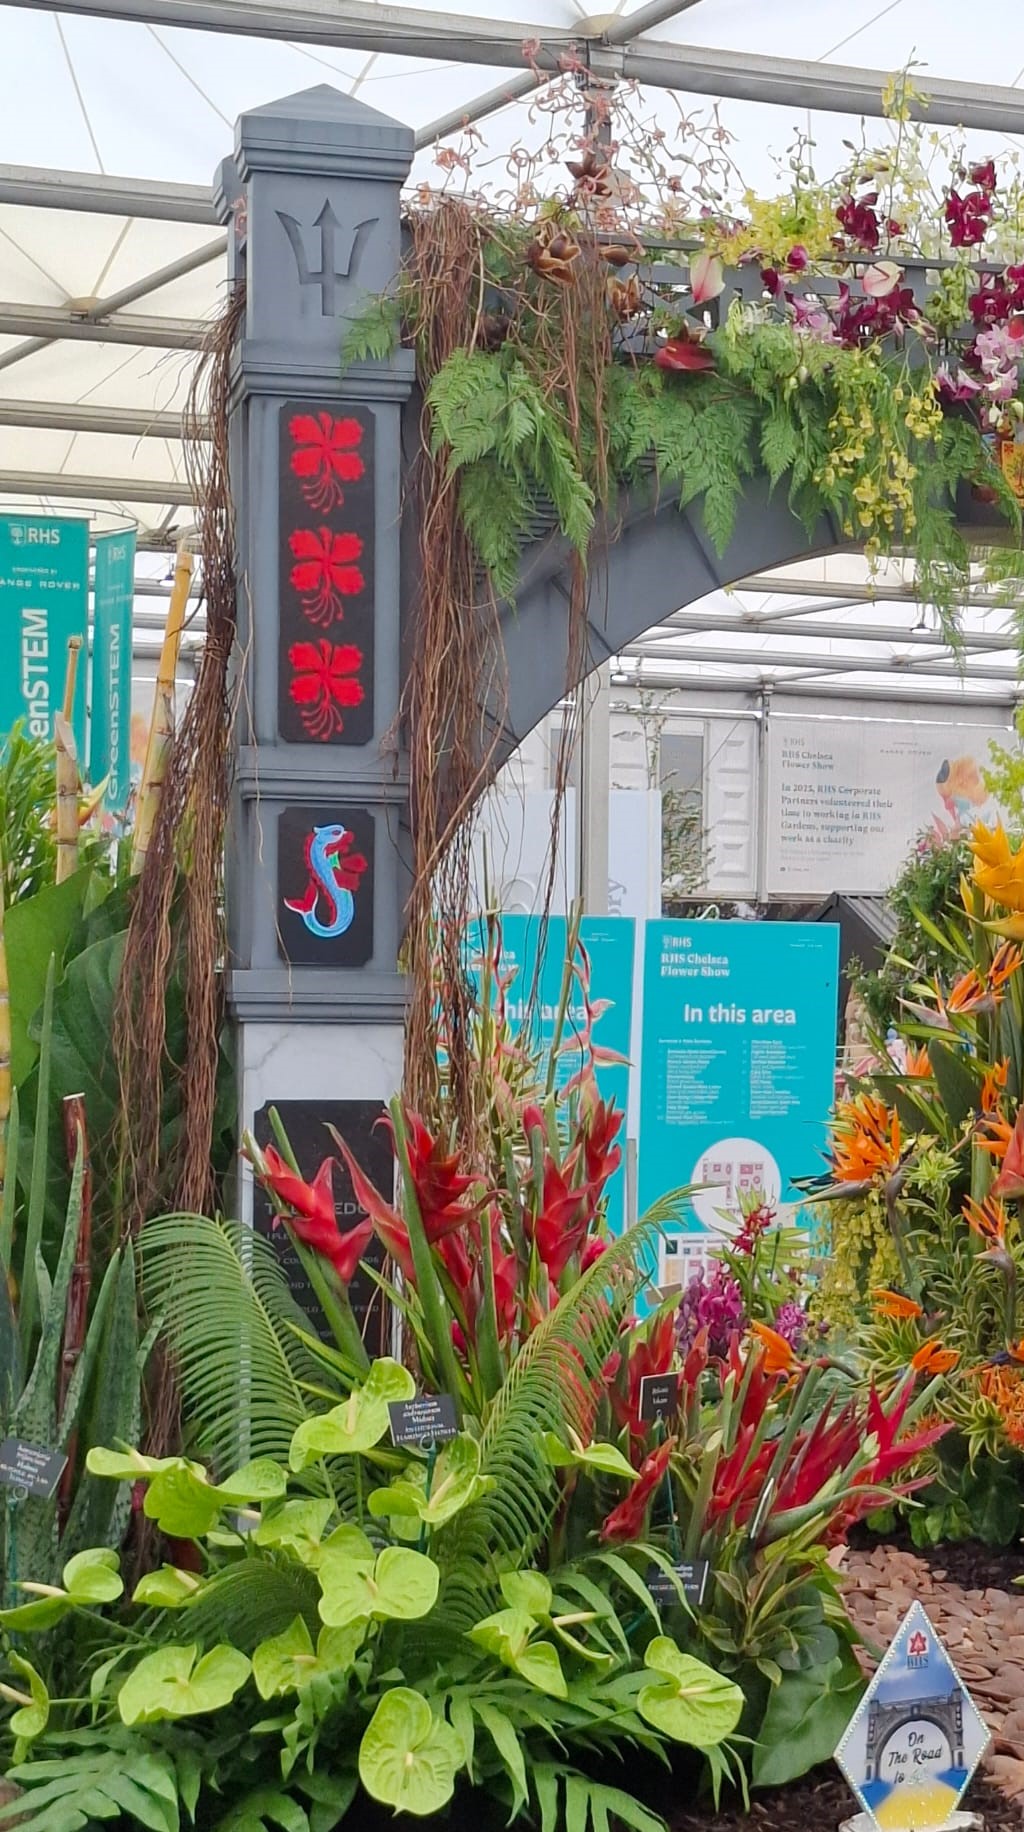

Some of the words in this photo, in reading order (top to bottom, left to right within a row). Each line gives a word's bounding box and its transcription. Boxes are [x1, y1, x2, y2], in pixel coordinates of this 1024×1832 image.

[28, 527, 60, 544] RHS
[0, 578, 32, 588] ANGE
[40, 580, 80, 589] ROVER
[22, 608, 49, 742] enSTEM
[801, 751, 833, 760] Chelsea
[782, 760, 810, 769] Flower
[812, 761, 834, 770] Show
[672, 936, 692, 948] RHS
[661, 954, 685, 964] RHS
[687, 953, 729, 966] Chelsea
[660, 966, 699, 977] Flower
[701, 966, 730, 977] Show
[684, 1003, 703, 1023] In
[709, 1003, 746, 1024] this
[752, 1008, 797, 1025] area
[908, 1731, 924, 1747] On
[888, 1751, 908, 1767] The
[913, 1745, 943, 1765] Road
